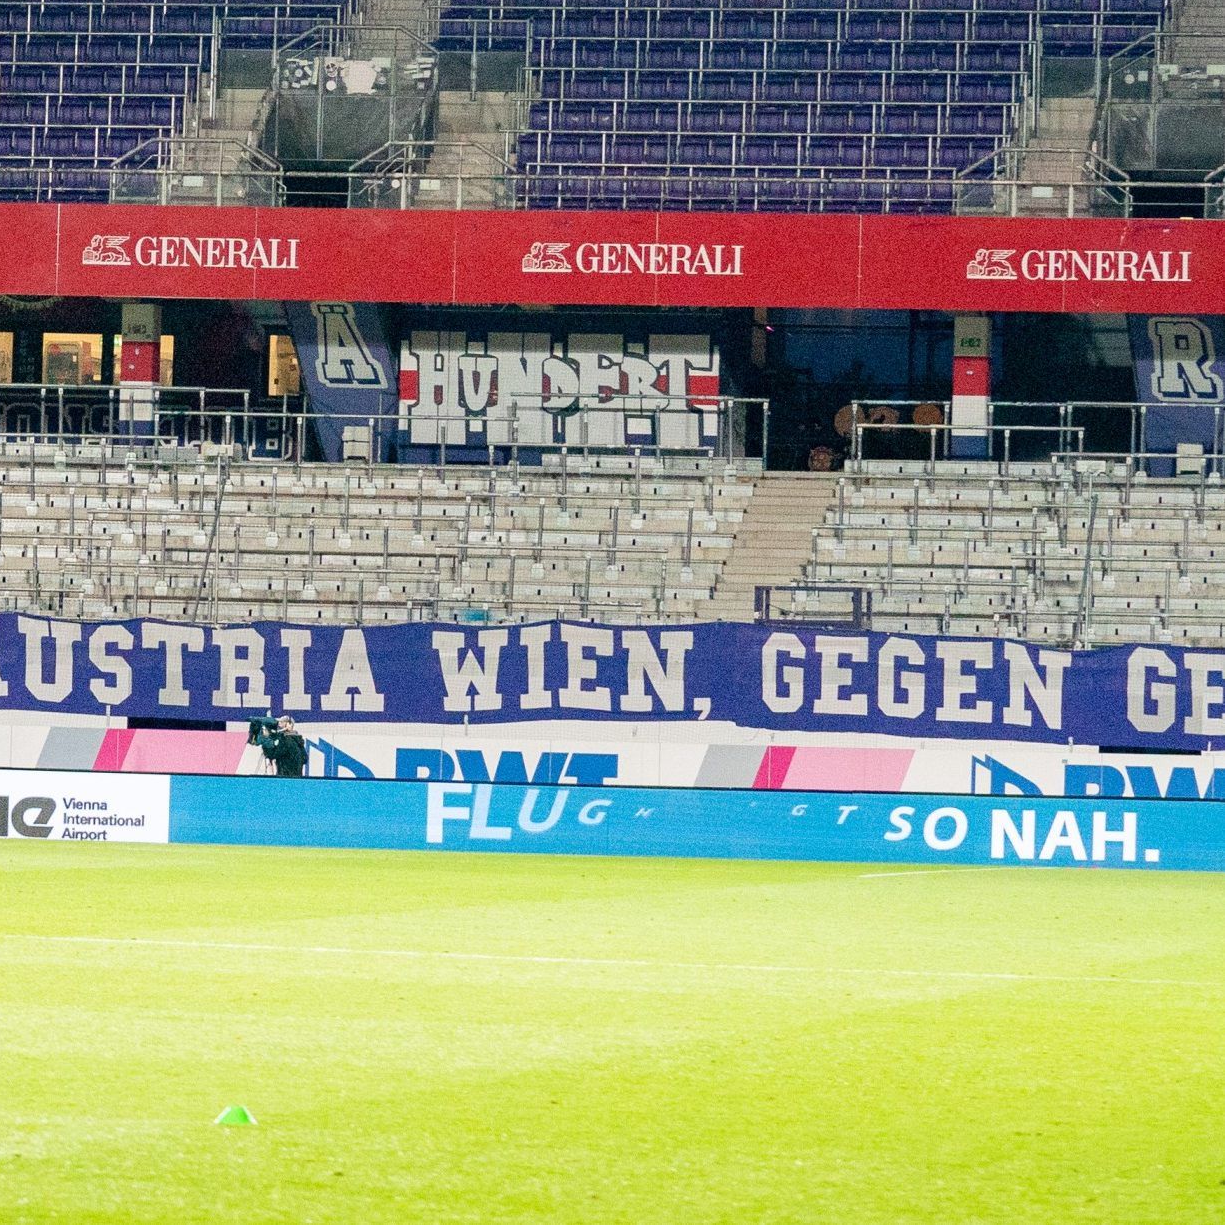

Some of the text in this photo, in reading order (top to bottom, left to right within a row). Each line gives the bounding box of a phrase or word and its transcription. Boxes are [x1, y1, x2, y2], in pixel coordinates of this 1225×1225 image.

[135, 235, 299, 270] GENERALI
[575, 242, 744, 277] GENERALI
[1020, 248, 1193, 283] GENERALI
[431, 623, 712, 721] WIEN,
[761, 631, 1072, 730] GEGEN
[62, 797, 108, 811] Vienna
[62, 812, 145, 827] International
[61, 827, 108, 841] Airport
[883, 805, 969, 851] SO
[990, 808, 1161, 863] NAH.
